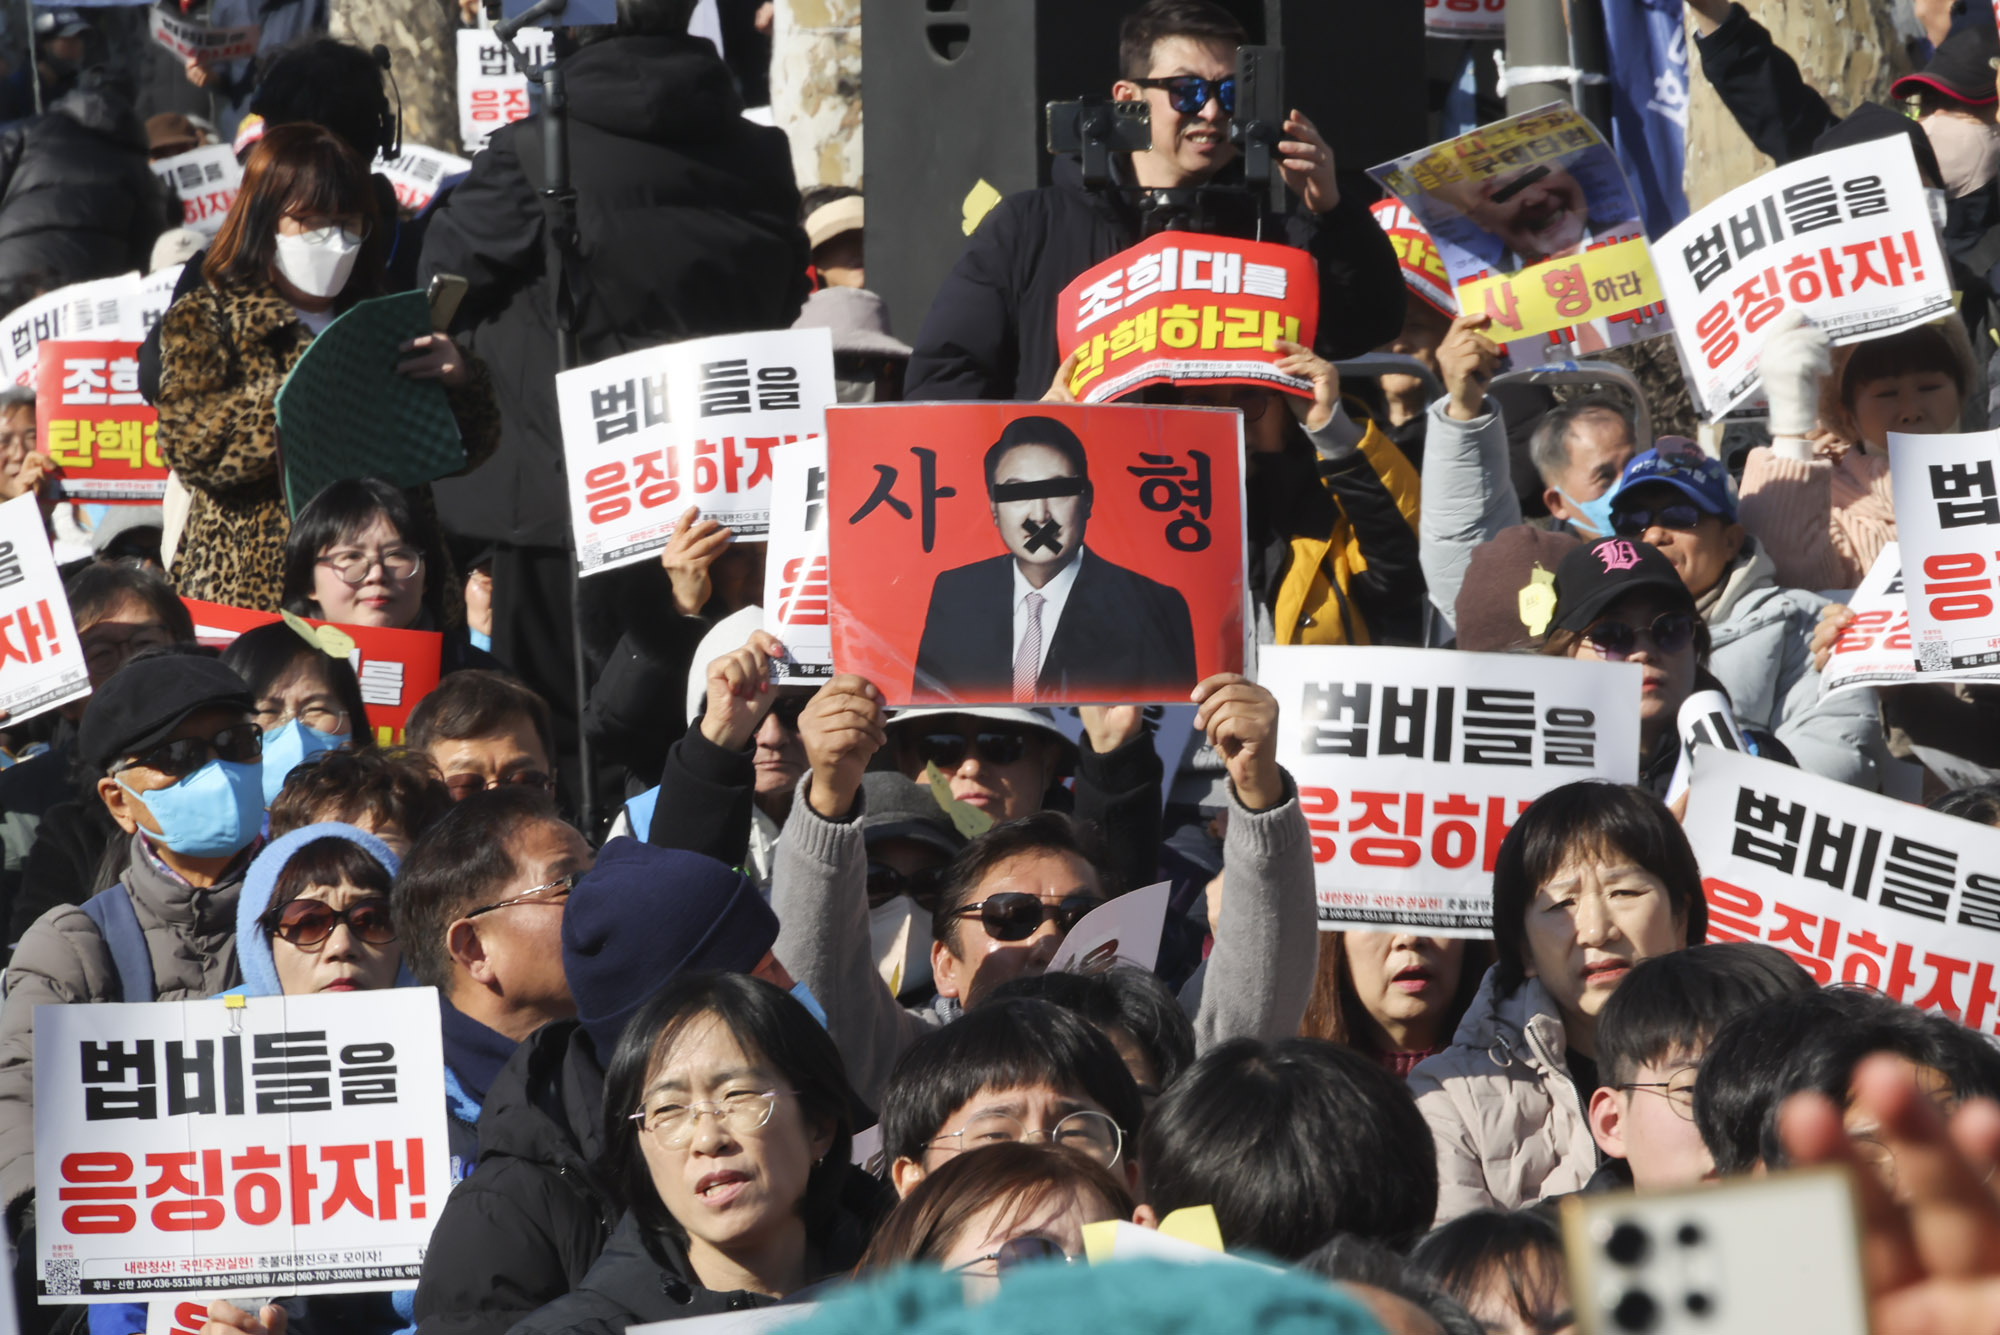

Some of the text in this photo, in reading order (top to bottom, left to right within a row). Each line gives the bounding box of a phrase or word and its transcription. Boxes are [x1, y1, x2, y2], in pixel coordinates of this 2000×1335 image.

[1682, 174, 1891, 294] 법비들을
[1076, 247, 1288, 333] 조희대를
[1695, 229, 1926, 370] 응징하자!
[848, 446, 957, 554] 사
[1125, 449, 1213, 552] 형
[1301, 681, 1597, 769] 법비들을
[80, 1030, 398, 1121] 법비들을
[59, 1137, 427, 1234] 응징하자!
[93, 1281, 111, 1292] 후원
[117, 1279, 135, 1291] 신한
[277, 1271, 296, 1283] ARS
[124, 1249, 383, 1275] 내란청산! 국민주권실현! 촛불대행진으로 모이자!
